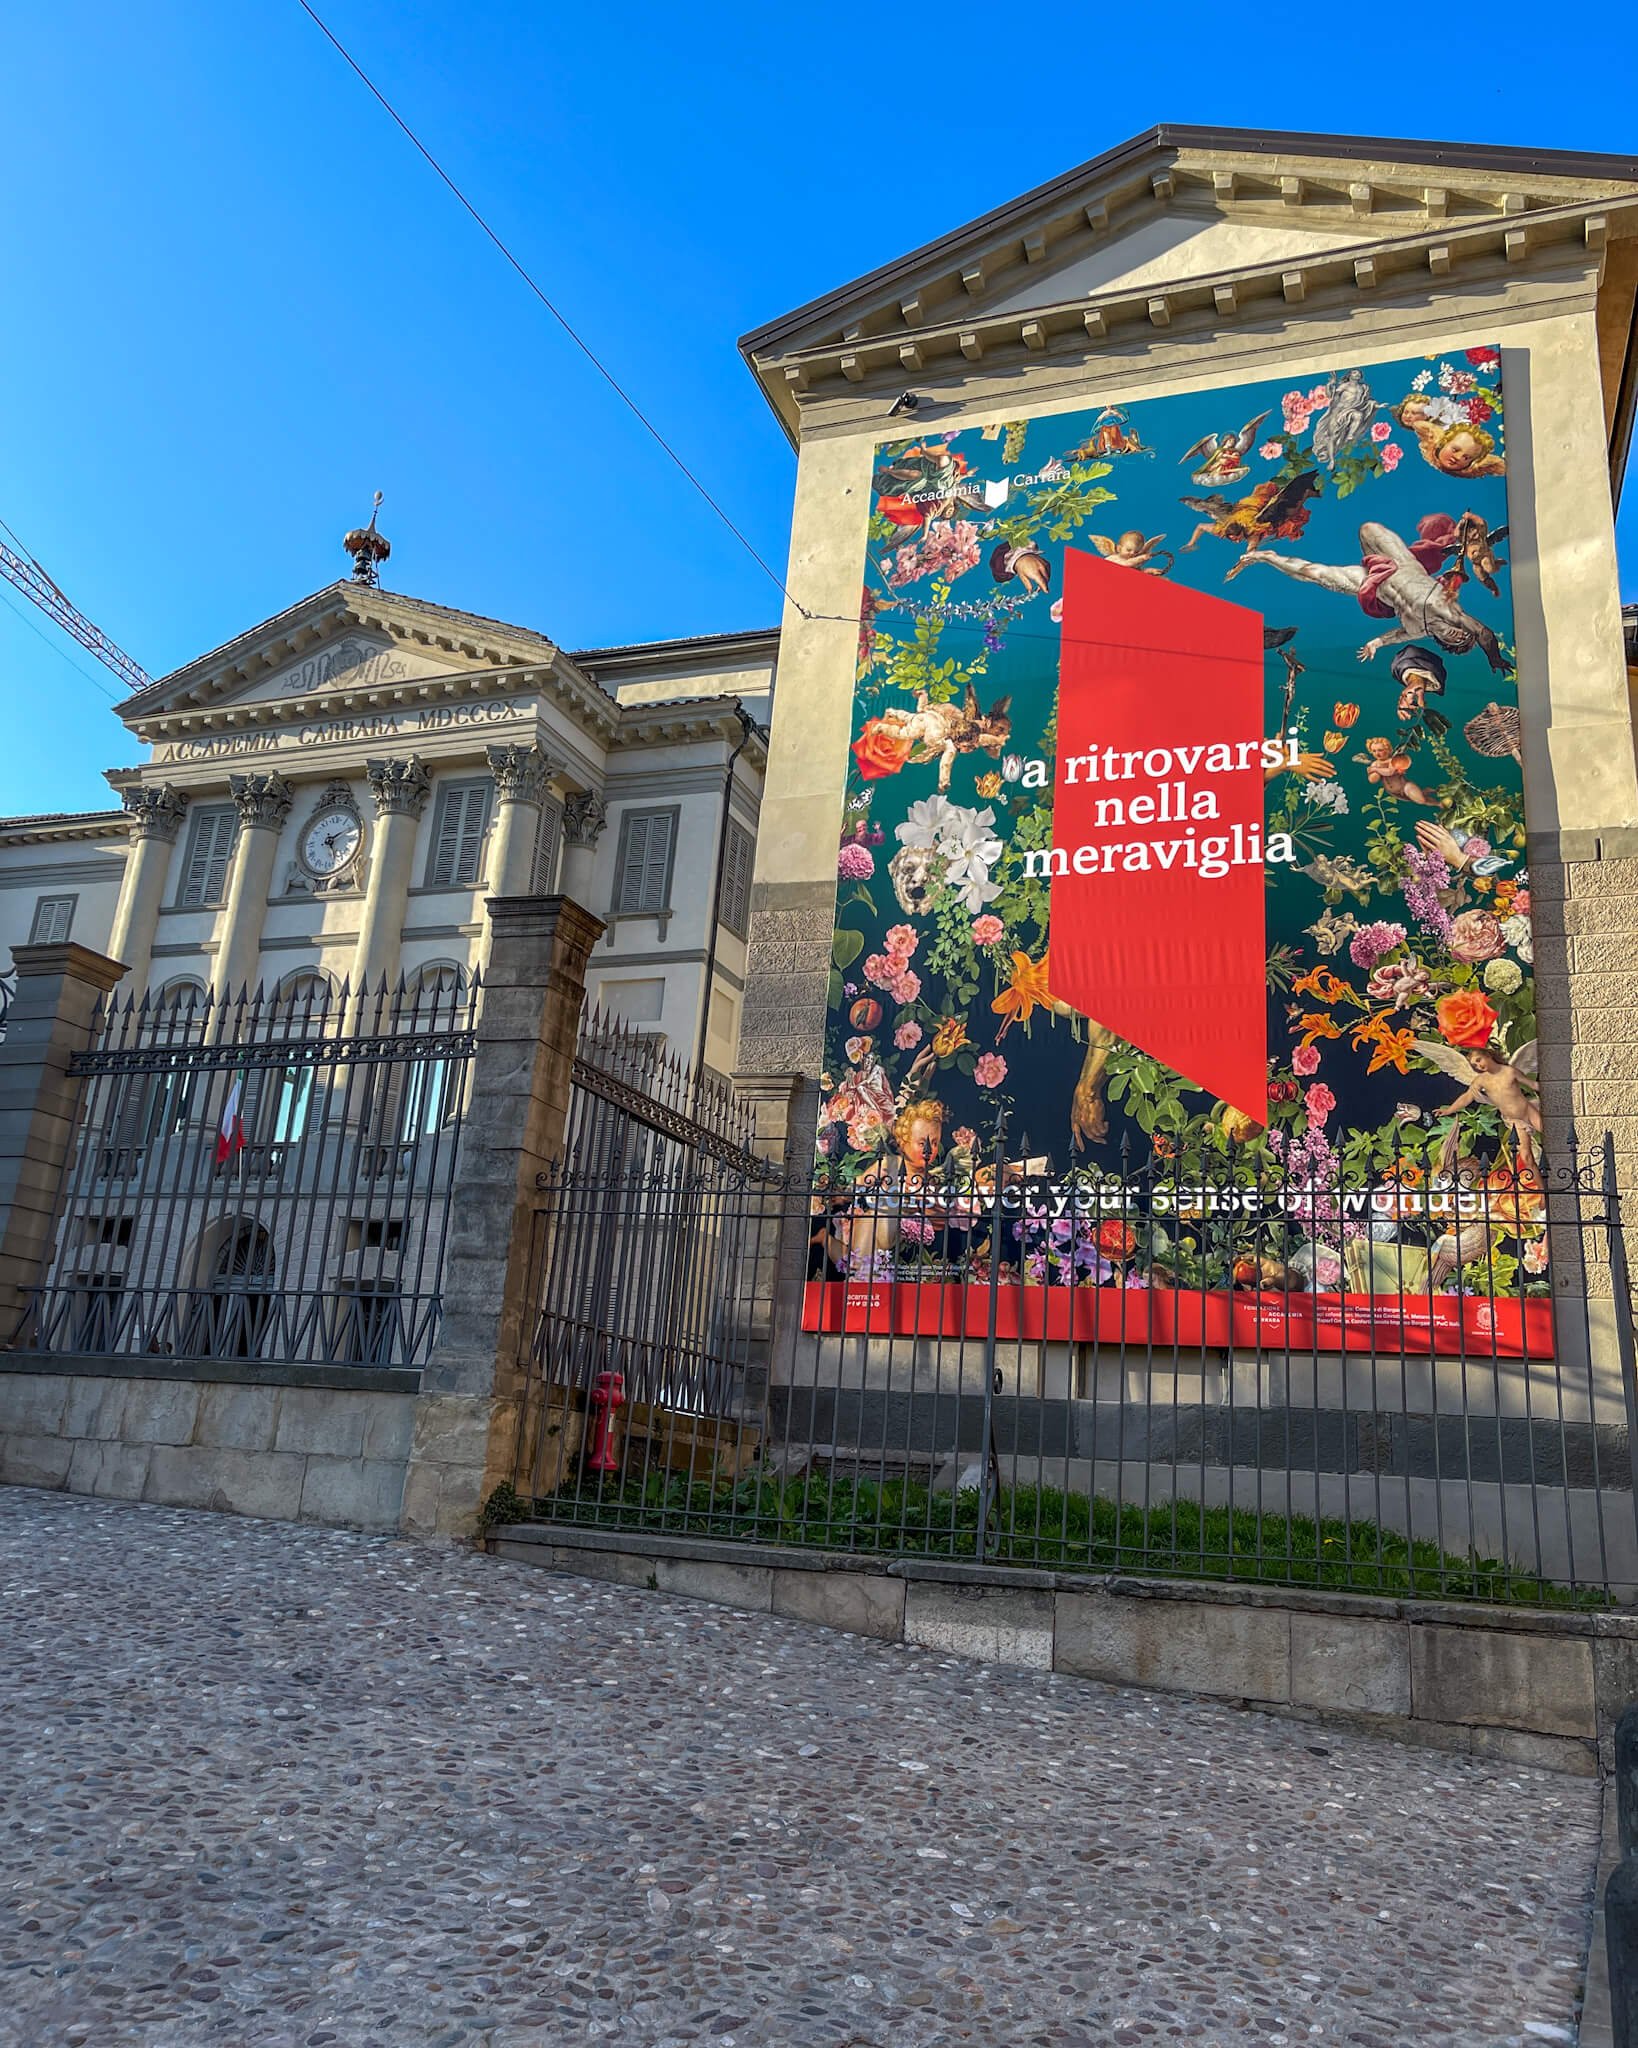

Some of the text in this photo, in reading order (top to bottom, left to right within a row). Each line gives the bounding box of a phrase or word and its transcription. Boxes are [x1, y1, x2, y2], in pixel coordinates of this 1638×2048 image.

[901, 469, 1071, 506] Accademia Carrara
[162, 731, 280, 763] ACCADEMIA
[299, 715, 399, 745] CARRARA
[1021, 727, 1302, 788] a ritrovarsi
[1094, 781, 1220, 827] nella
[1022, 822, 1297, 879] meraviglia
[1050, 1184, 1140, 1217] your
[1151, 1185, 1264, 1212] sense
[1278, 1177, 1323, 1212] of
